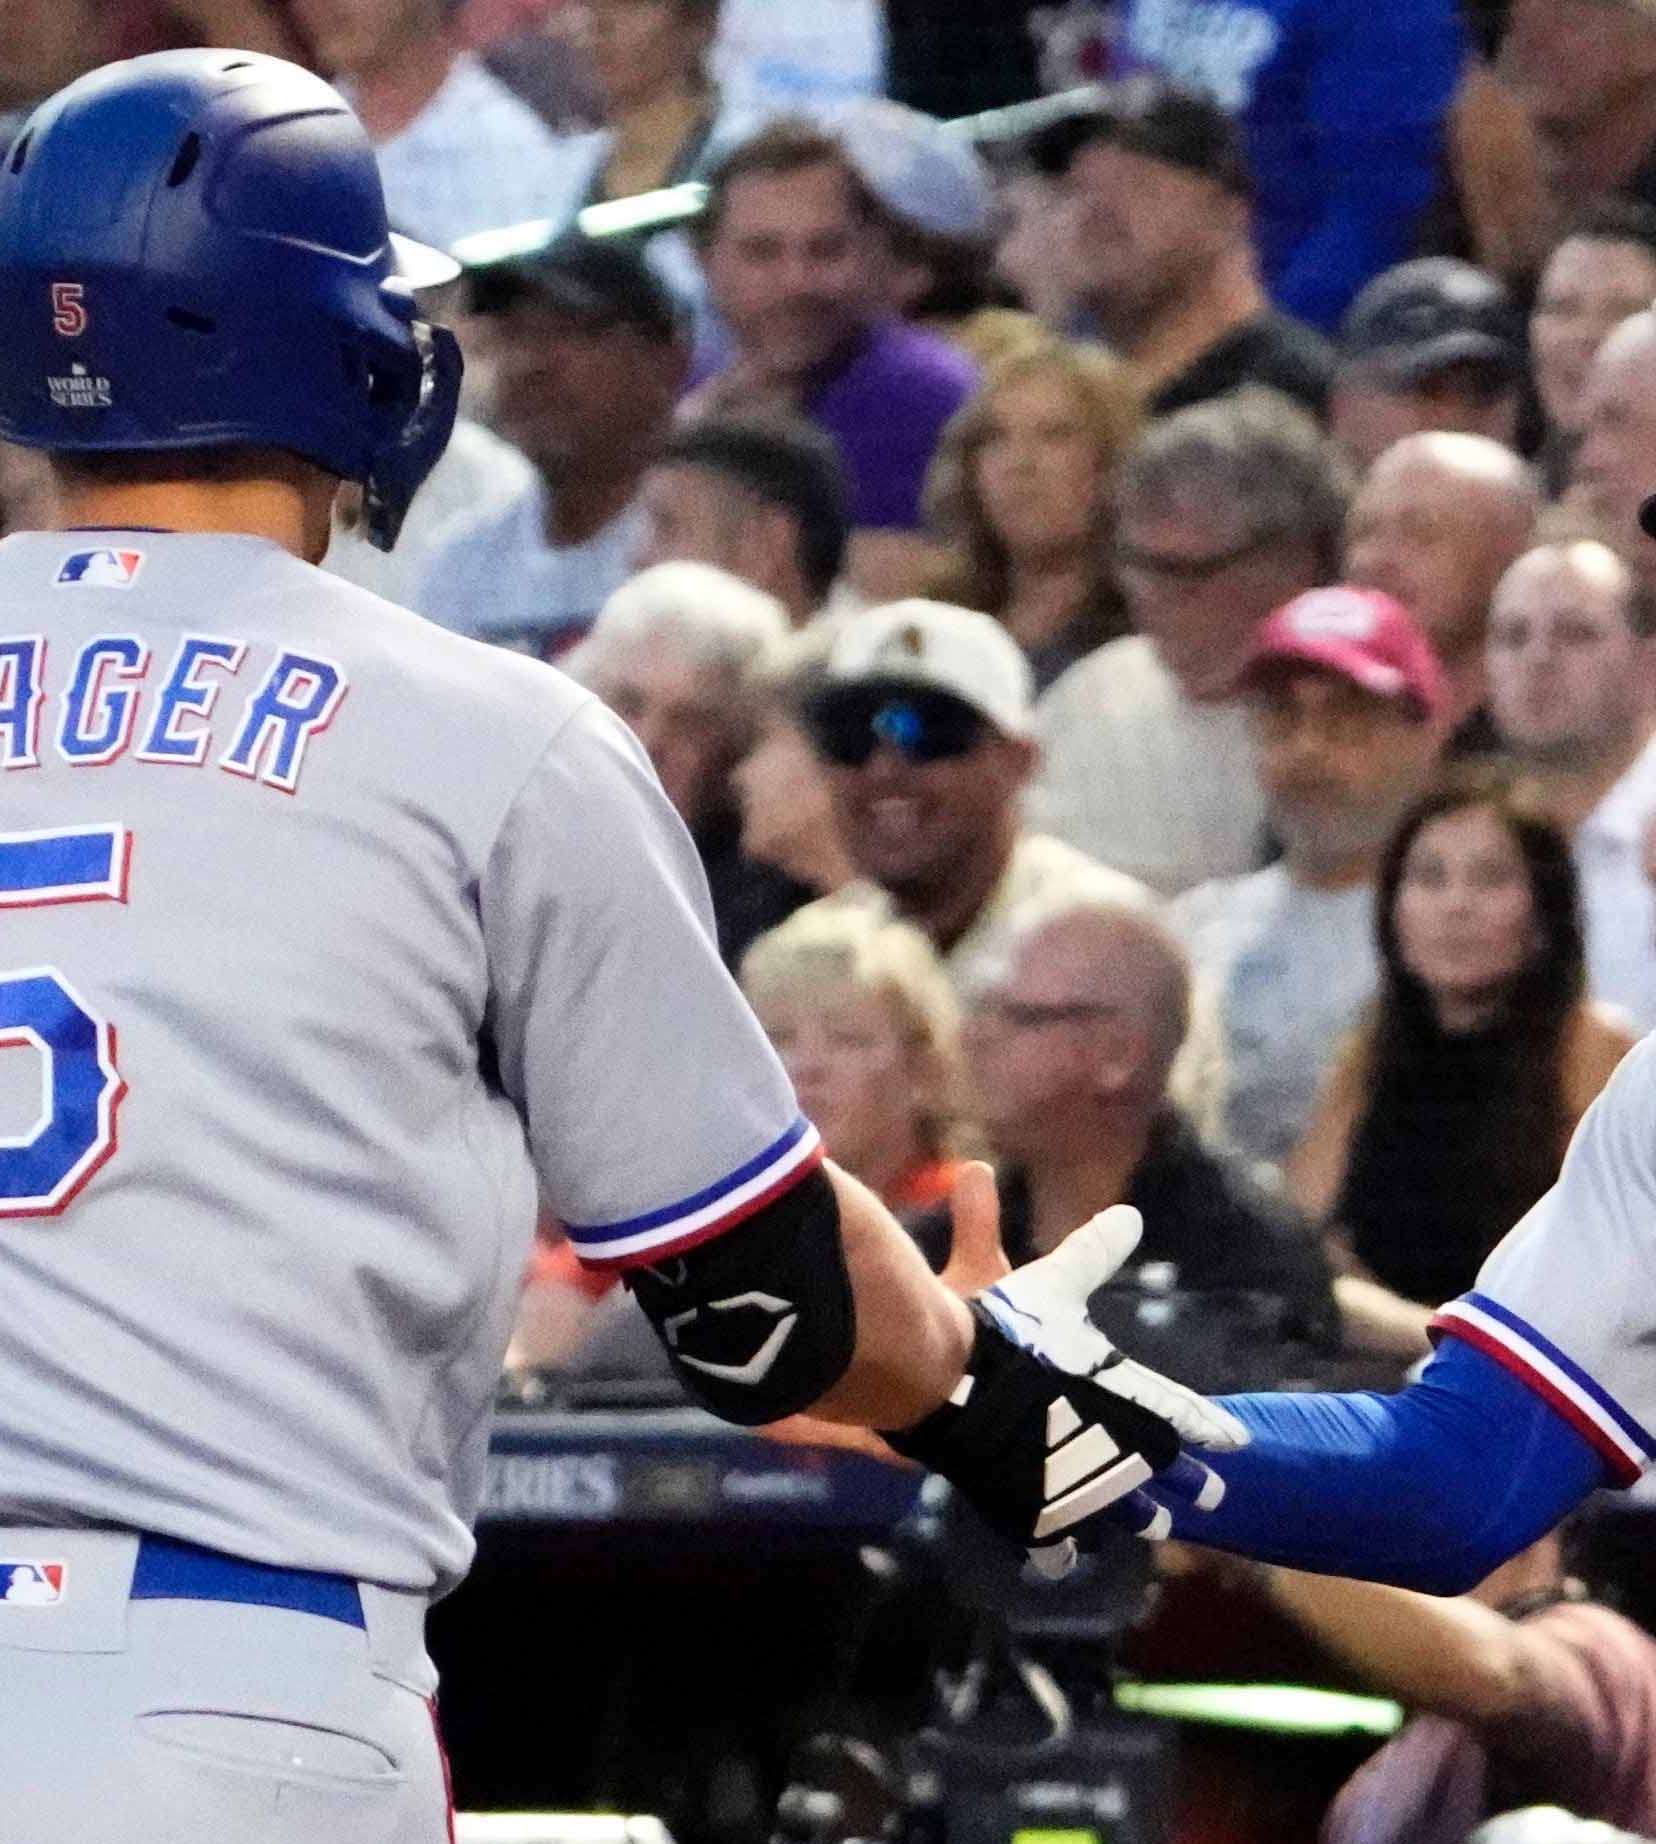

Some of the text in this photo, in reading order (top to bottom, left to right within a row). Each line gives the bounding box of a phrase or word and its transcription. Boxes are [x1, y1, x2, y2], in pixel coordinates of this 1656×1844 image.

[51, 282, 87, 337] 5
[47, 376, 111, 391] WORLD
[49, 390, 113, 407] SERIES
[488, 1454, 617, 1517] RIES
